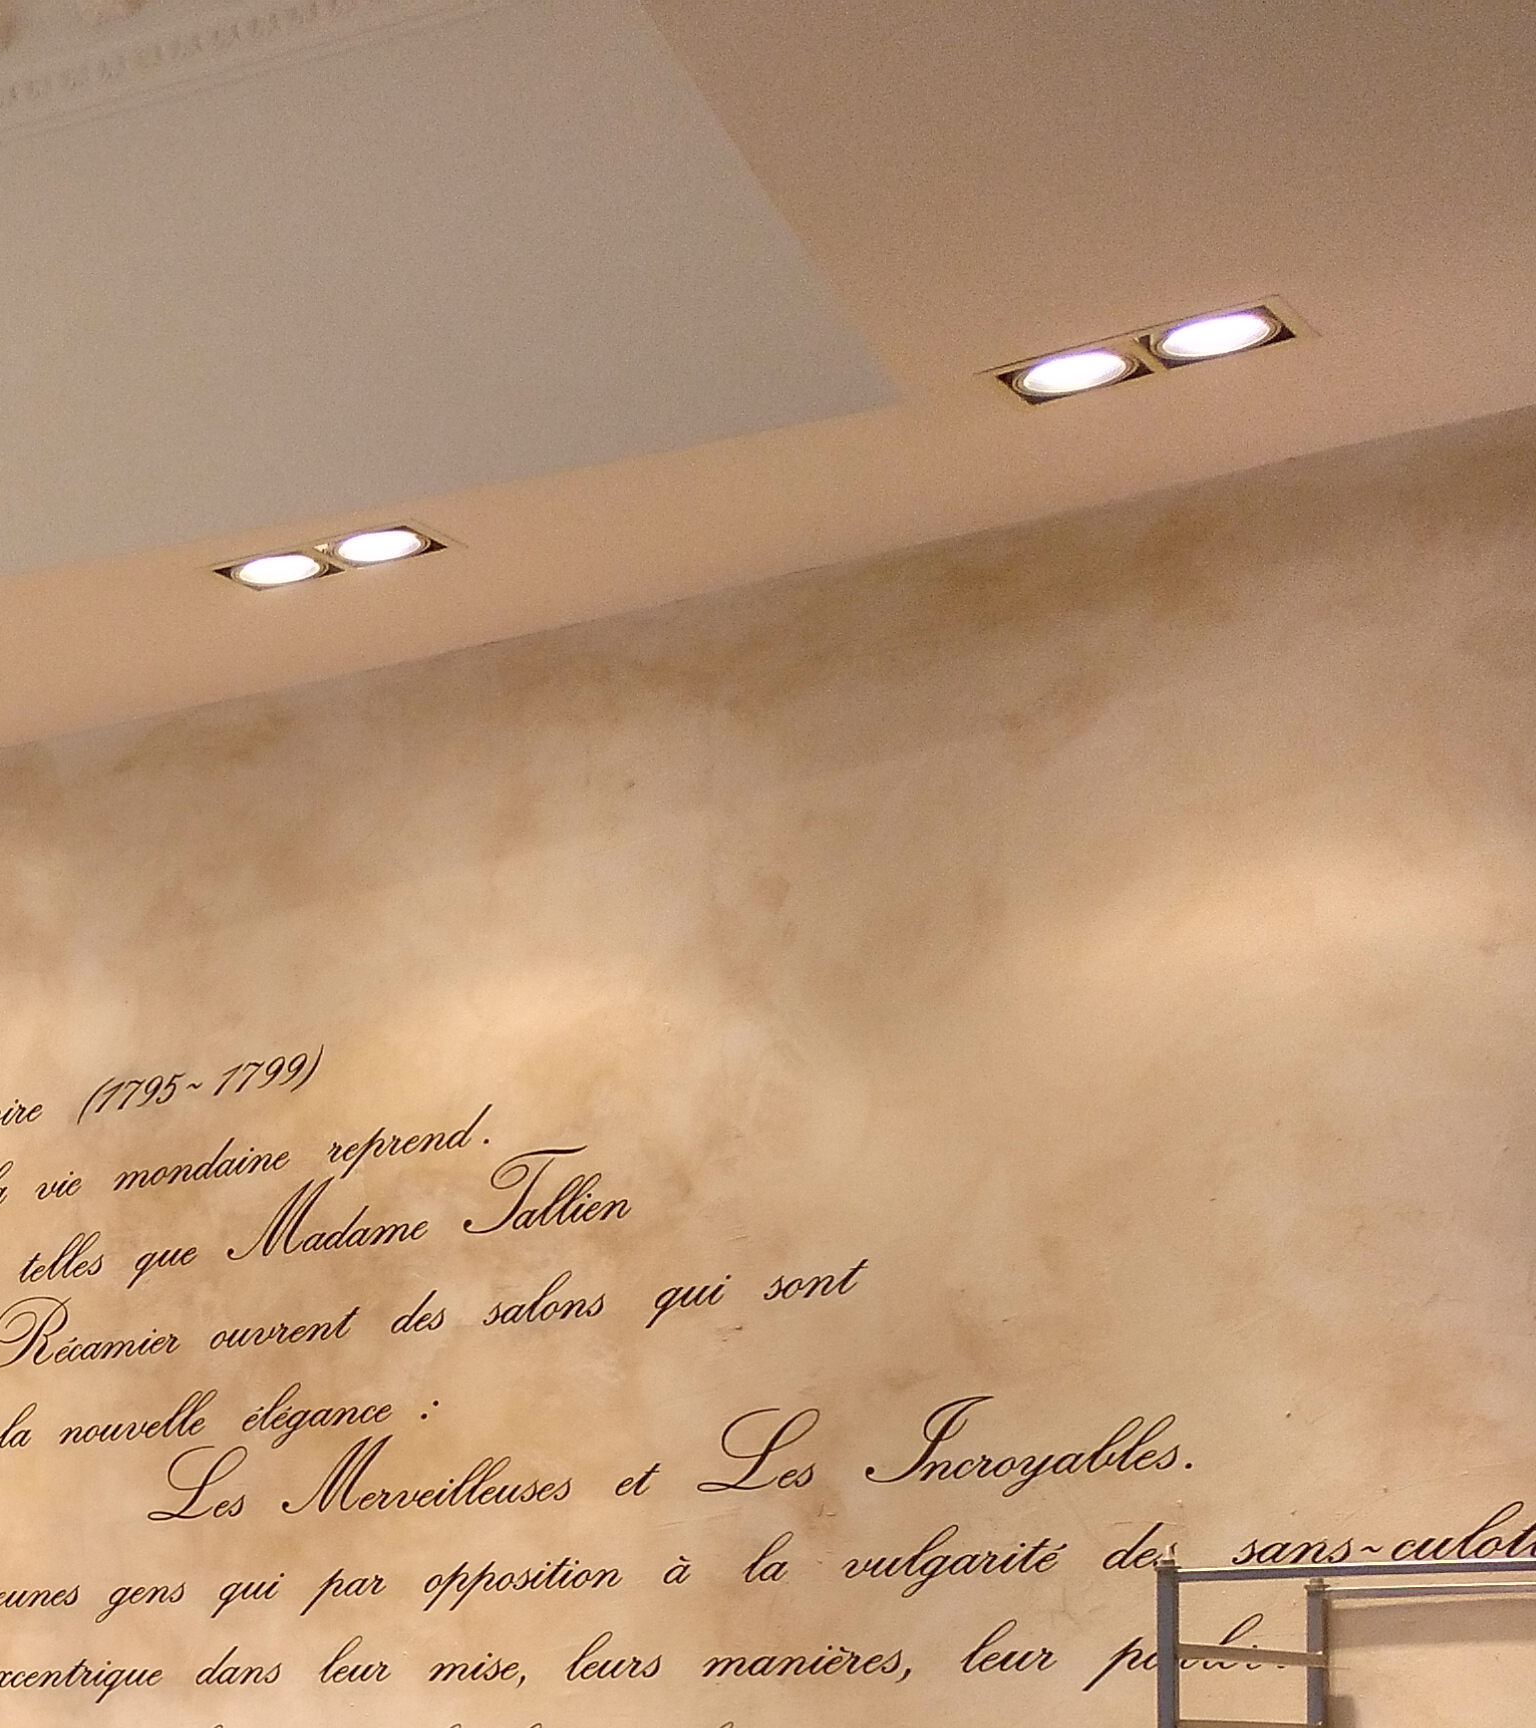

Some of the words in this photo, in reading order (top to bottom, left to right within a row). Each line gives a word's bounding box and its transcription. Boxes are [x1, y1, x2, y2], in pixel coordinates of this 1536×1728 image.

[35, 1171, 82, 1200] vie
[113, 1137, 290, 1191] mondaine
[327, 1103, 493, 1179] reprend.
[18, 1231, 104, 1283] telles
[126, 1247, 198, 1289] que
[226, 1173, 429, 1261] Madame
[463, 1145, 632, 1234] Tallien
[210, 1306, 361, 1350] ouvrent
[391, 1290, 446, 1334] des
[483, 1270, 606, 1326] salons
[645, 1274, 732, 1329] qui
[763, 1259, 868, 1300] sont
[59, 1389, 218, 1446] nouvelle
[242, 1382, 393, 1451] élégance
[147, 1446, 248, 1521] Les
[282, 1434, 572, 1514] Merveilleuses
[615, 1463, 661, 1496] et
[697, 1408, 820, 1492] Les
[865, 1396, 1192, 1497] Incroyables.
[95, 1582, 186, 1623] gens
[210, 1573, 285, 1619] qui
[299, 1568, 387, 1616] par
[423, 1557, 623, 1611] opposition
[663, 1555, 691, 1584] à
[742, 1531, 794, 1583] la
[841, 1524, 1068, 1598] vulgarité
[195, 1646, 282, 1685] dans
[318, 1635, 391, 1683] leur
[428, 1652, 526, 1688] mise,
[565, 1631, 662, 1681] leurs
[702, 1645, 912, 1684] manières,
[960, 1619, 1058, 1673] leur
